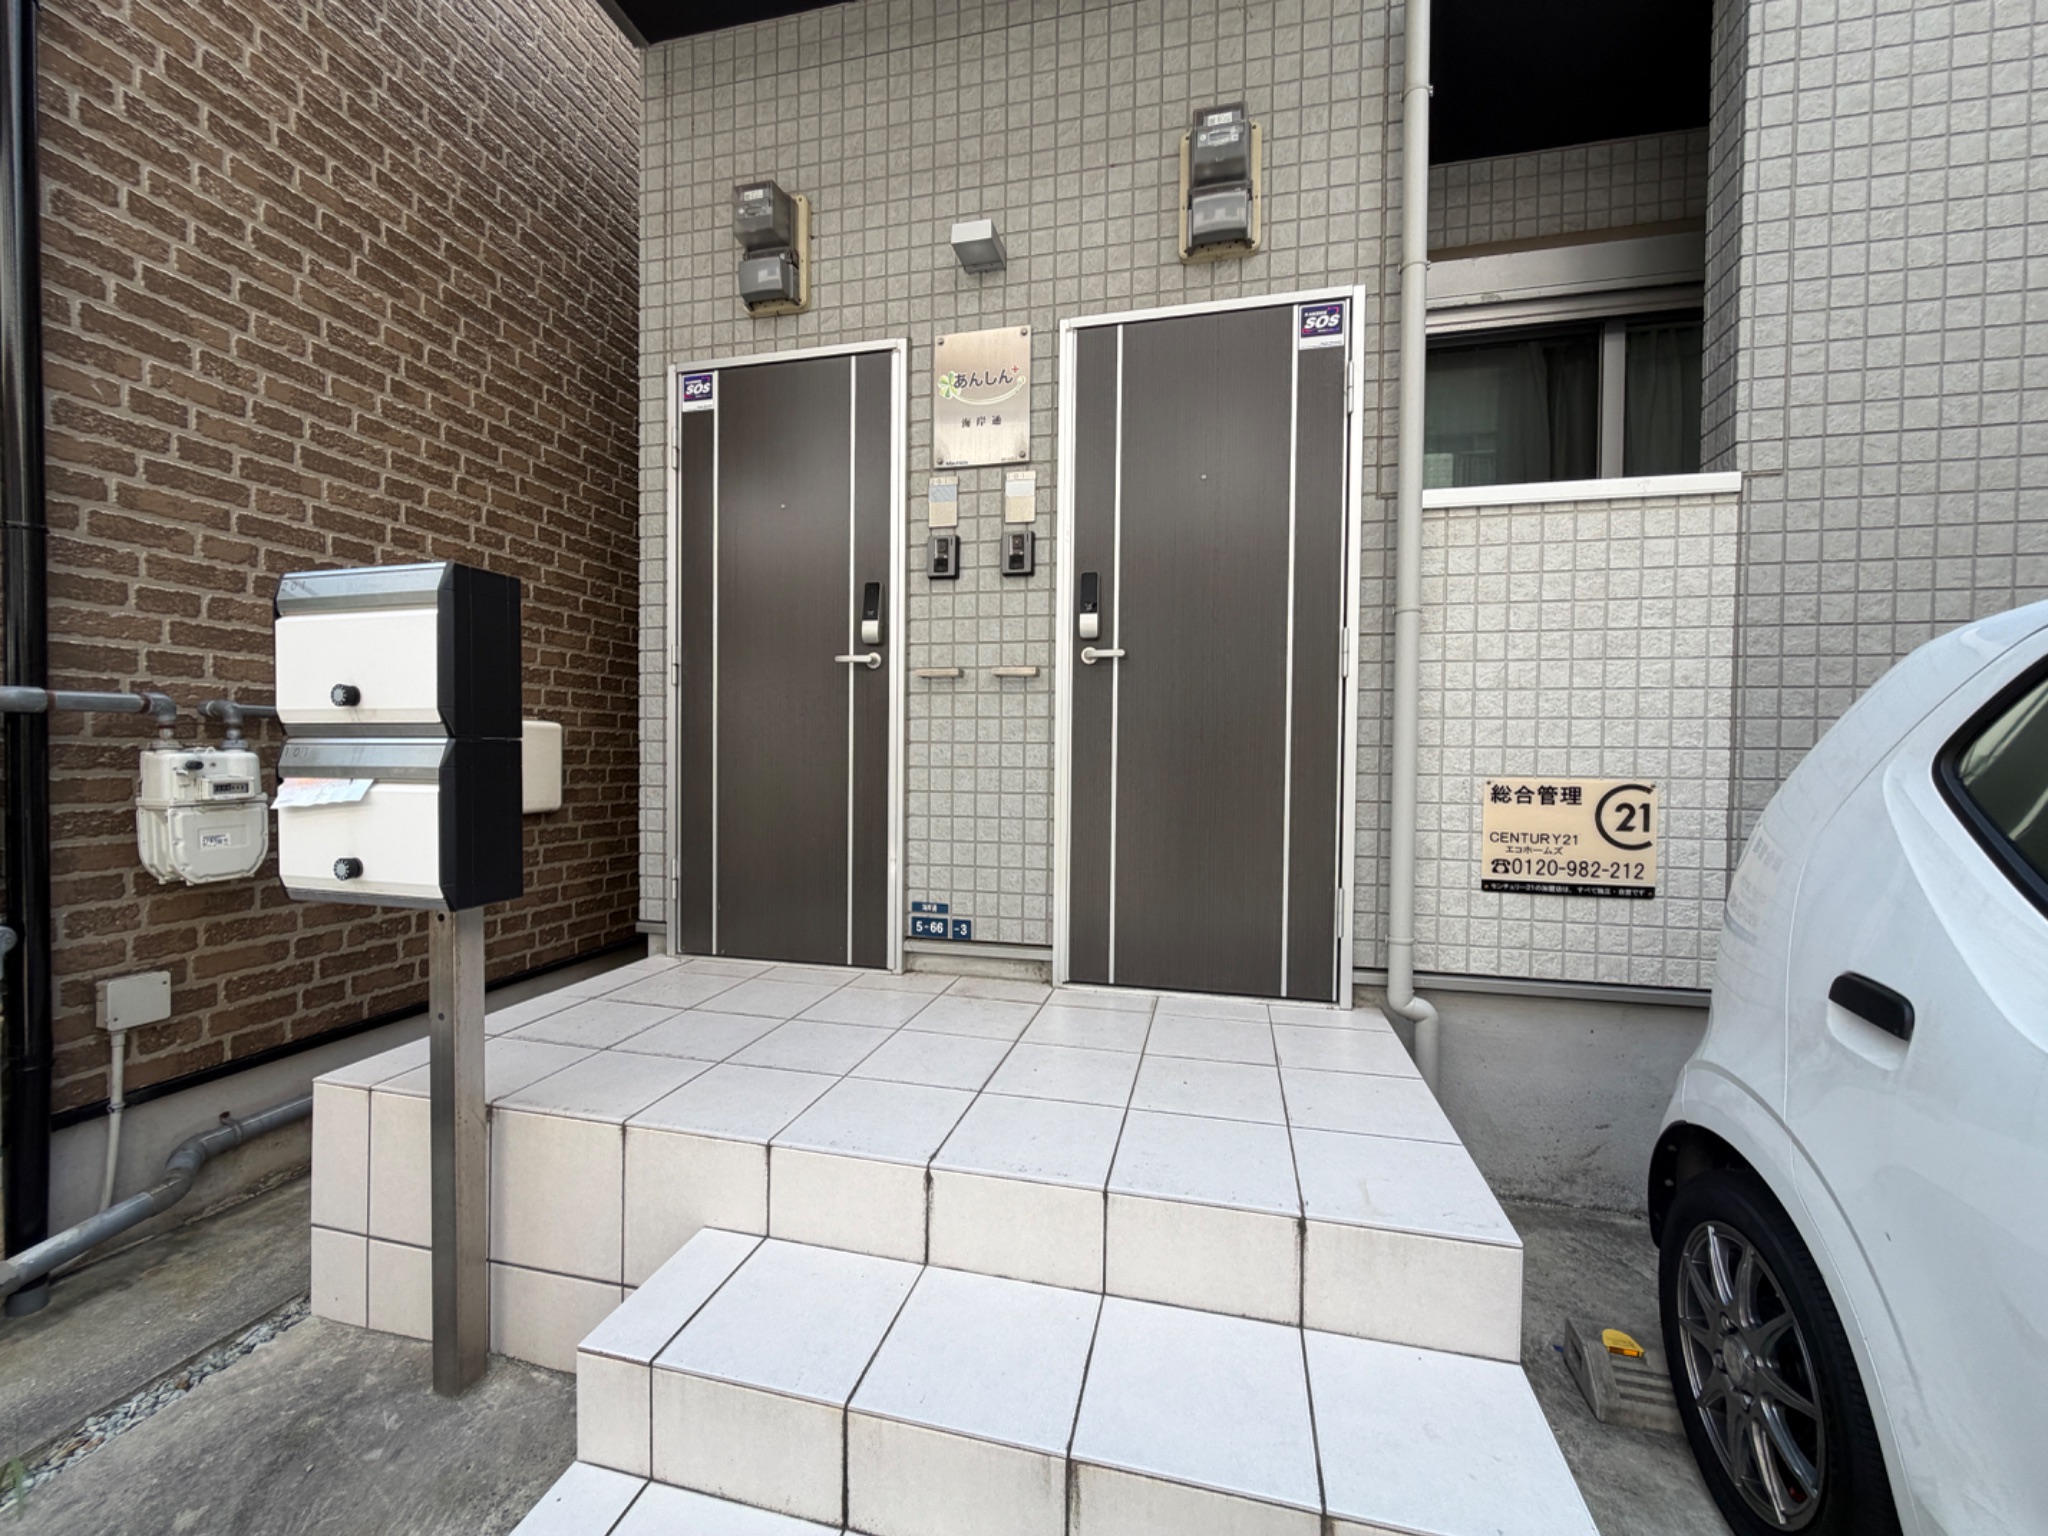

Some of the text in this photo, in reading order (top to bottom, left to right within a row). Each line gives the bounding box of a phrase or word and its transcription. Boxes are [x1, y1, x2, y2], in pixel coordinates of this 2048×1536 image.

[1304, 313, 1341, 329] SOS
[685, 382, 711, 395] SOS
[1490, 784, 1582, 806] 総合管理
[1614, 802, 1651, 833] 21
[1489, 831, 1579, 846] CENTURY21
[1505, 845, 1564, 856] エコホームズ
[1512, 858, 1645, 880] 0120-982-212
[915, 920, 944, 934] 5-66
